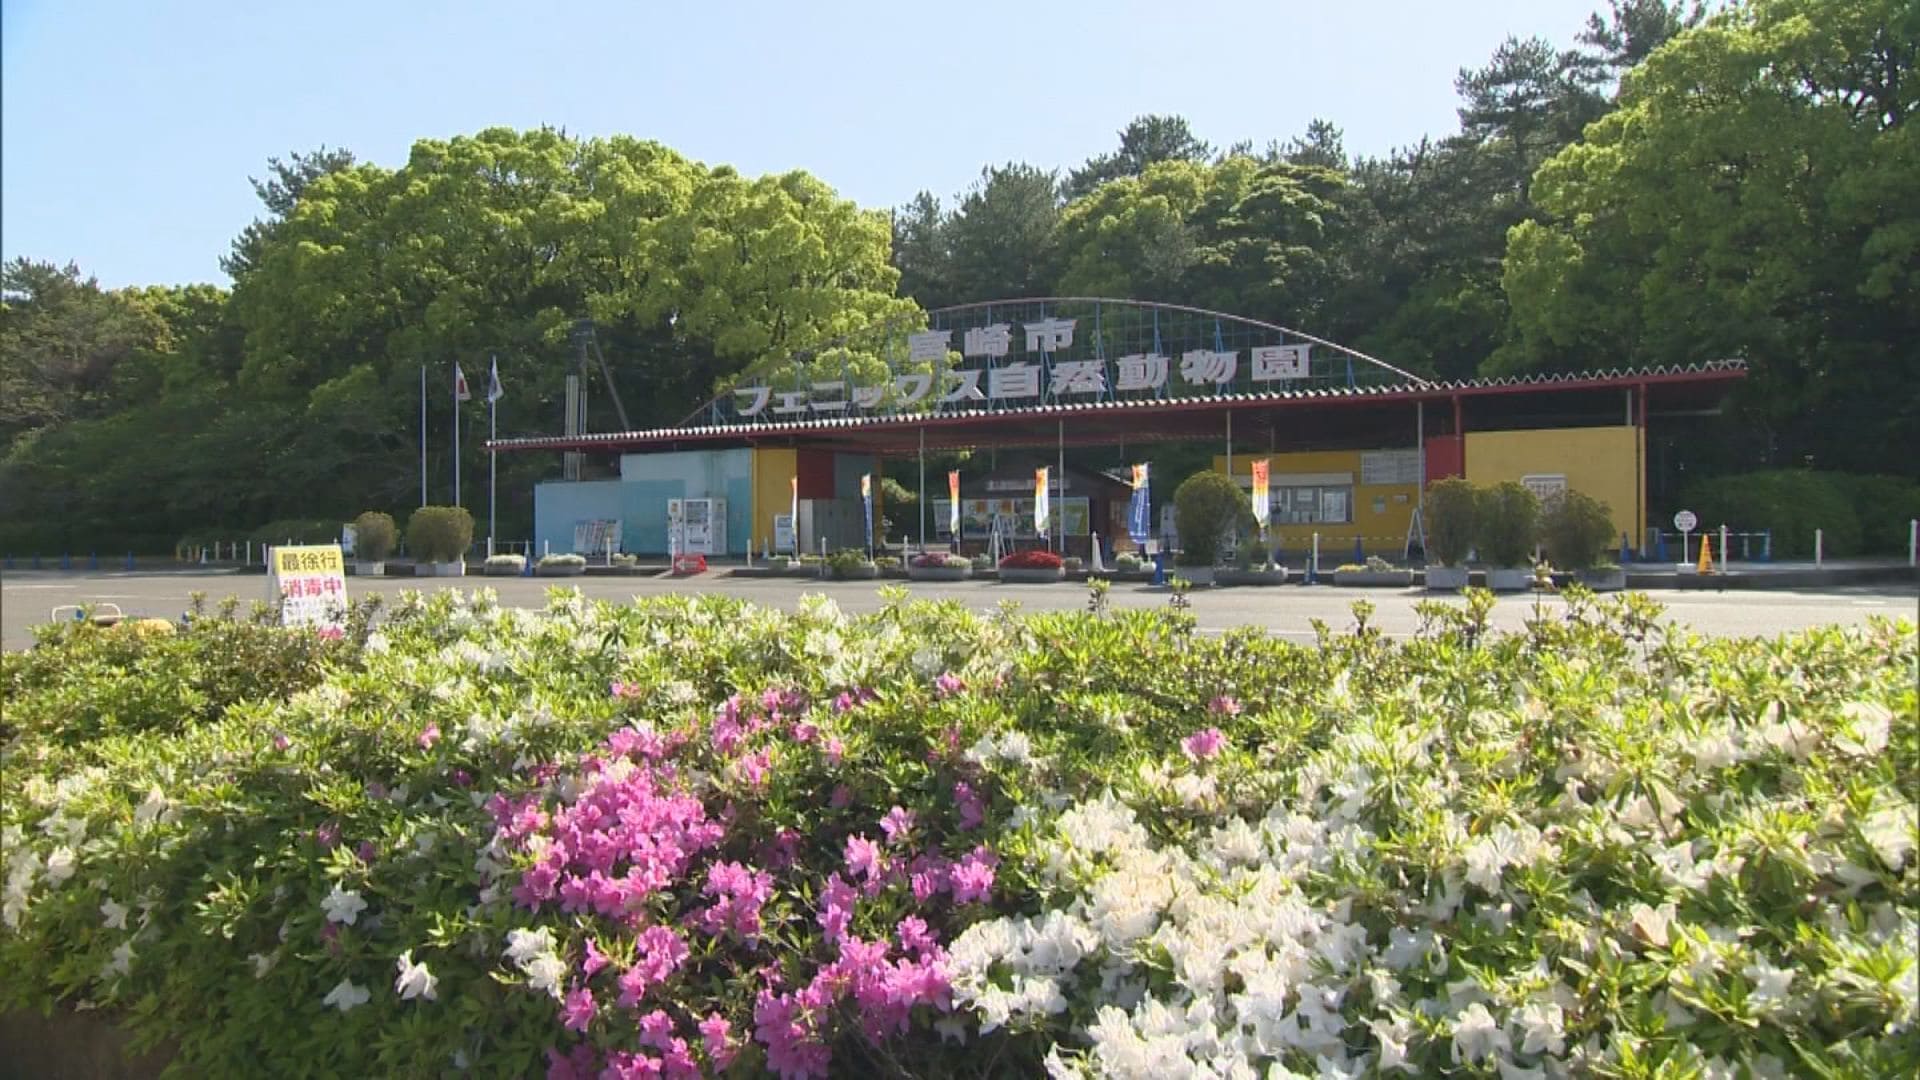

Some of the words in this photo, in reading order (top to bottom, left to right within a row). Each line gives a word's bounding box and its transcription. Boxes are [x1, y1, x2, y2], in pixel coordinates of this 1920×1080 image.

[734, 343, 1312, 413] フェニックス自然動物園
[282, 551, 337, 571] 最徐行
[281, 577, 342, 597] 消毒中
